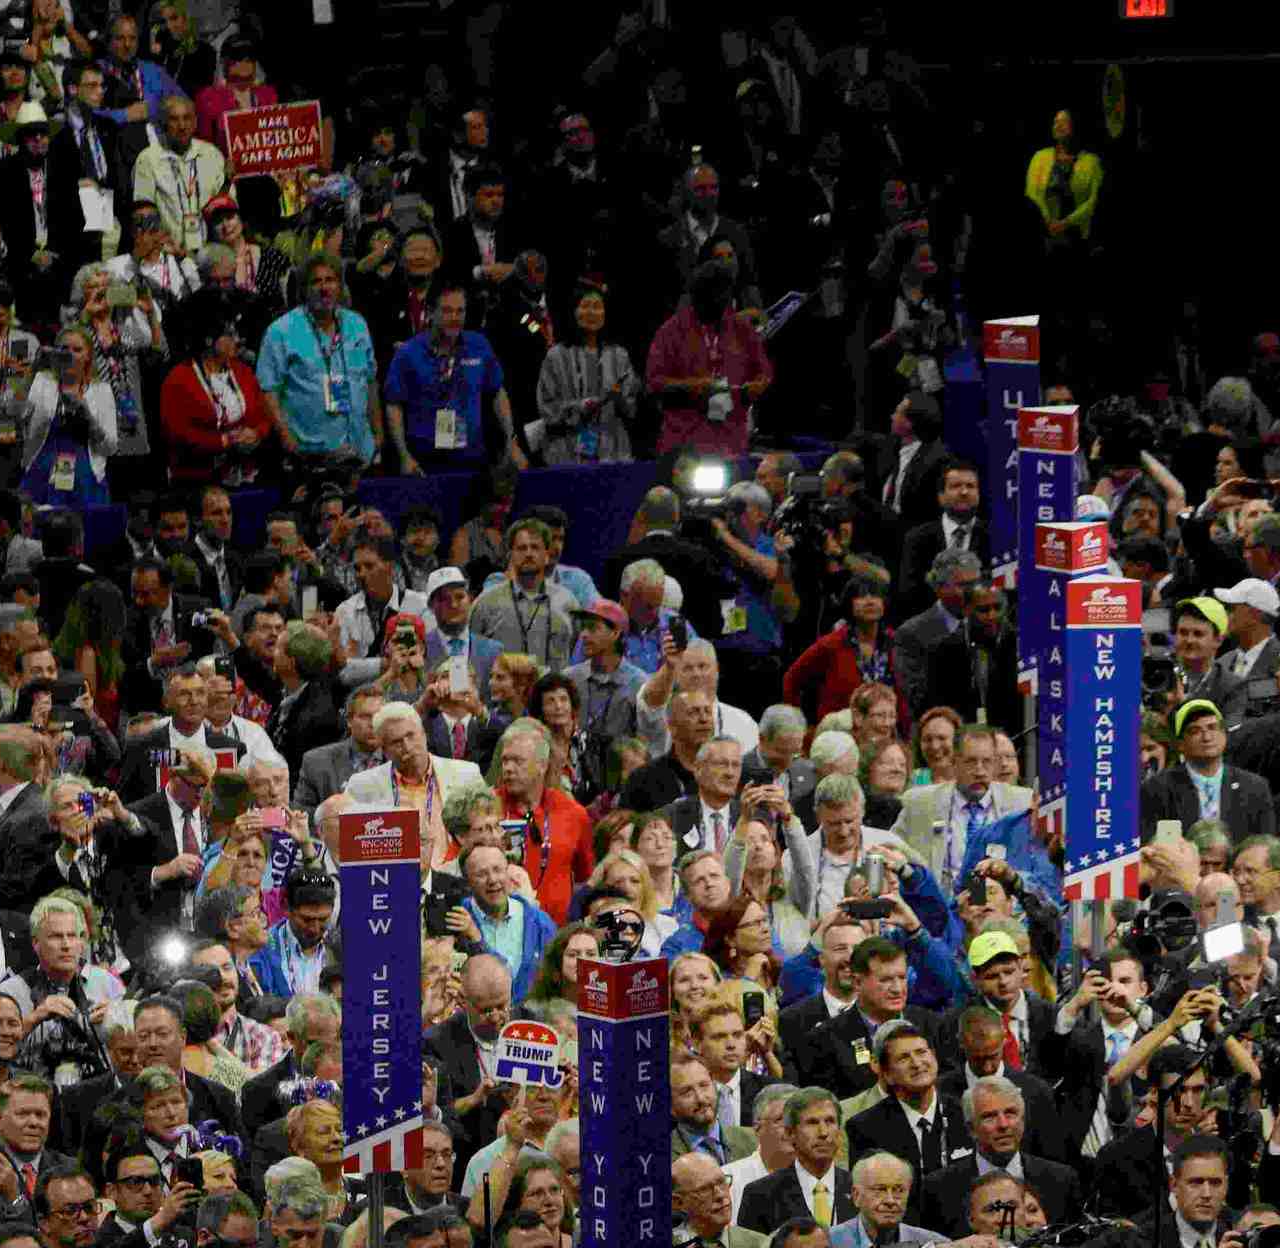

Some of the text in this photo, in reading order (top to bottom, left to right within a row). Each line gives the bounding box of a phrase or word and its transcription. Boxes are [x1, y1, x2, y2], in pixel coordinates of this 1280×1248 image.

[231, 126, 319, 152] AMERICA
[276, 143, 315, 161] AGAIN
[1047, 578, 1065, 767] ALASKA
[1093, 633, 1117, 839] NEW HAMPSHIRE
[367, 867, 393, 1104] NEW JERSEY
[506, 1044, 553, 1061] TRUMP
[590, 1027, 607, 1116] NEW
[635, 1027, 655, 1116] NEW
